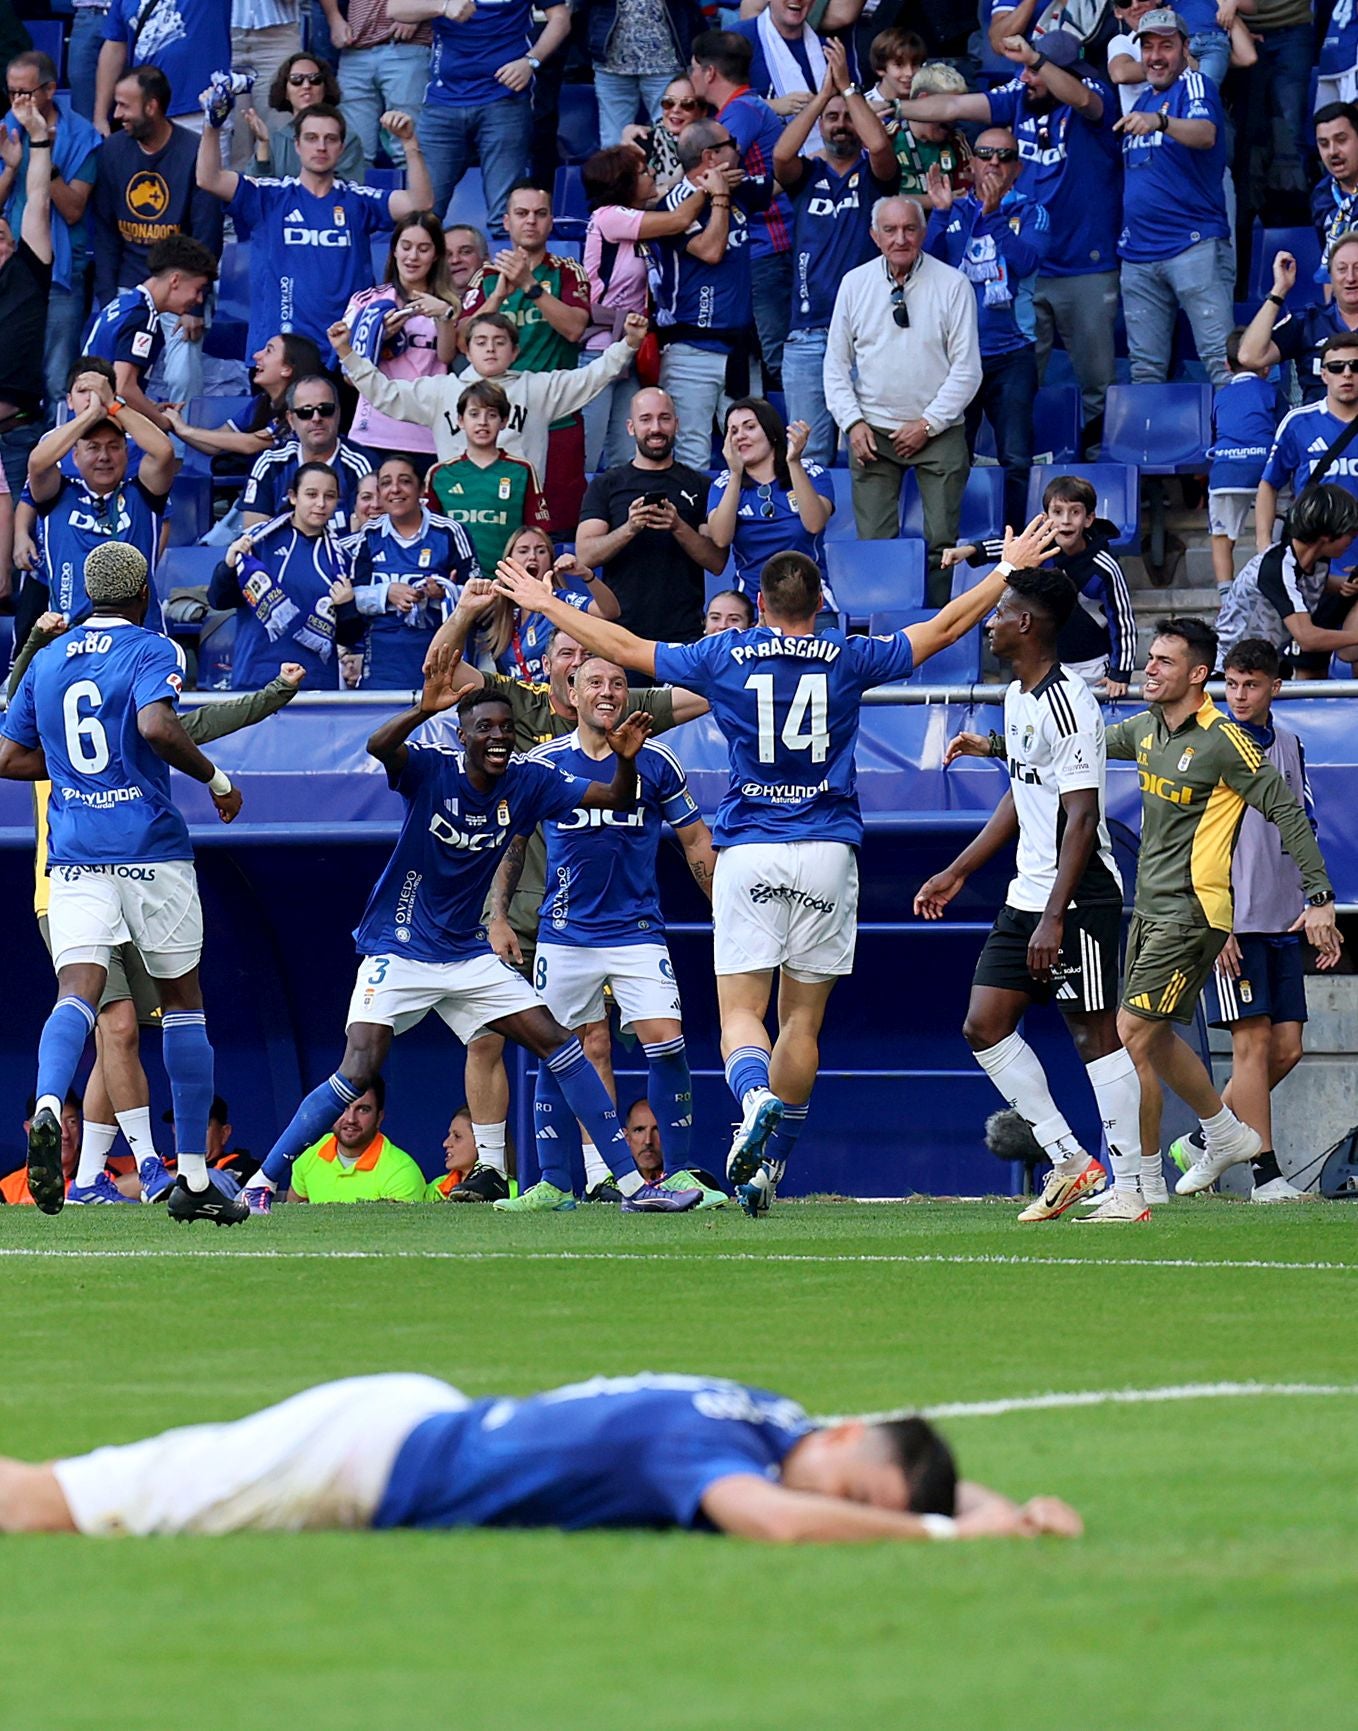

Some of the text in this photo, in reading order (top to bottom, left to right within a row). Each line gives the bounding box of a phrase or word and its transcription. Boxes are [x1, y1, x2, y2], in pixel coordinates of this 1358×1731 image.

[283, 227, 352, 247] DIGI
[447, 509, 507, 525] DIGI
[60, 562, 71, 610] OVIEDO
[730, 637, 841, 665] PARASCHIV
[63, 679, 110, 774] 6
[744, 673, 830, 764] 14
[75, 785, 143, 805] HYUNDAI
[1138, 770, 1193, 805] DIGI
[557, 806, 645, 829] DIGI
[428, 813, 507, 851] DIGI
[395, 870, 417, 924] OVIEDO
[368, 957, 390, 985] 3
[536, 956, 548, 990] 8
[535, 1102, 552, 1112] RO
[604, 1110, 617, 1120] RO
